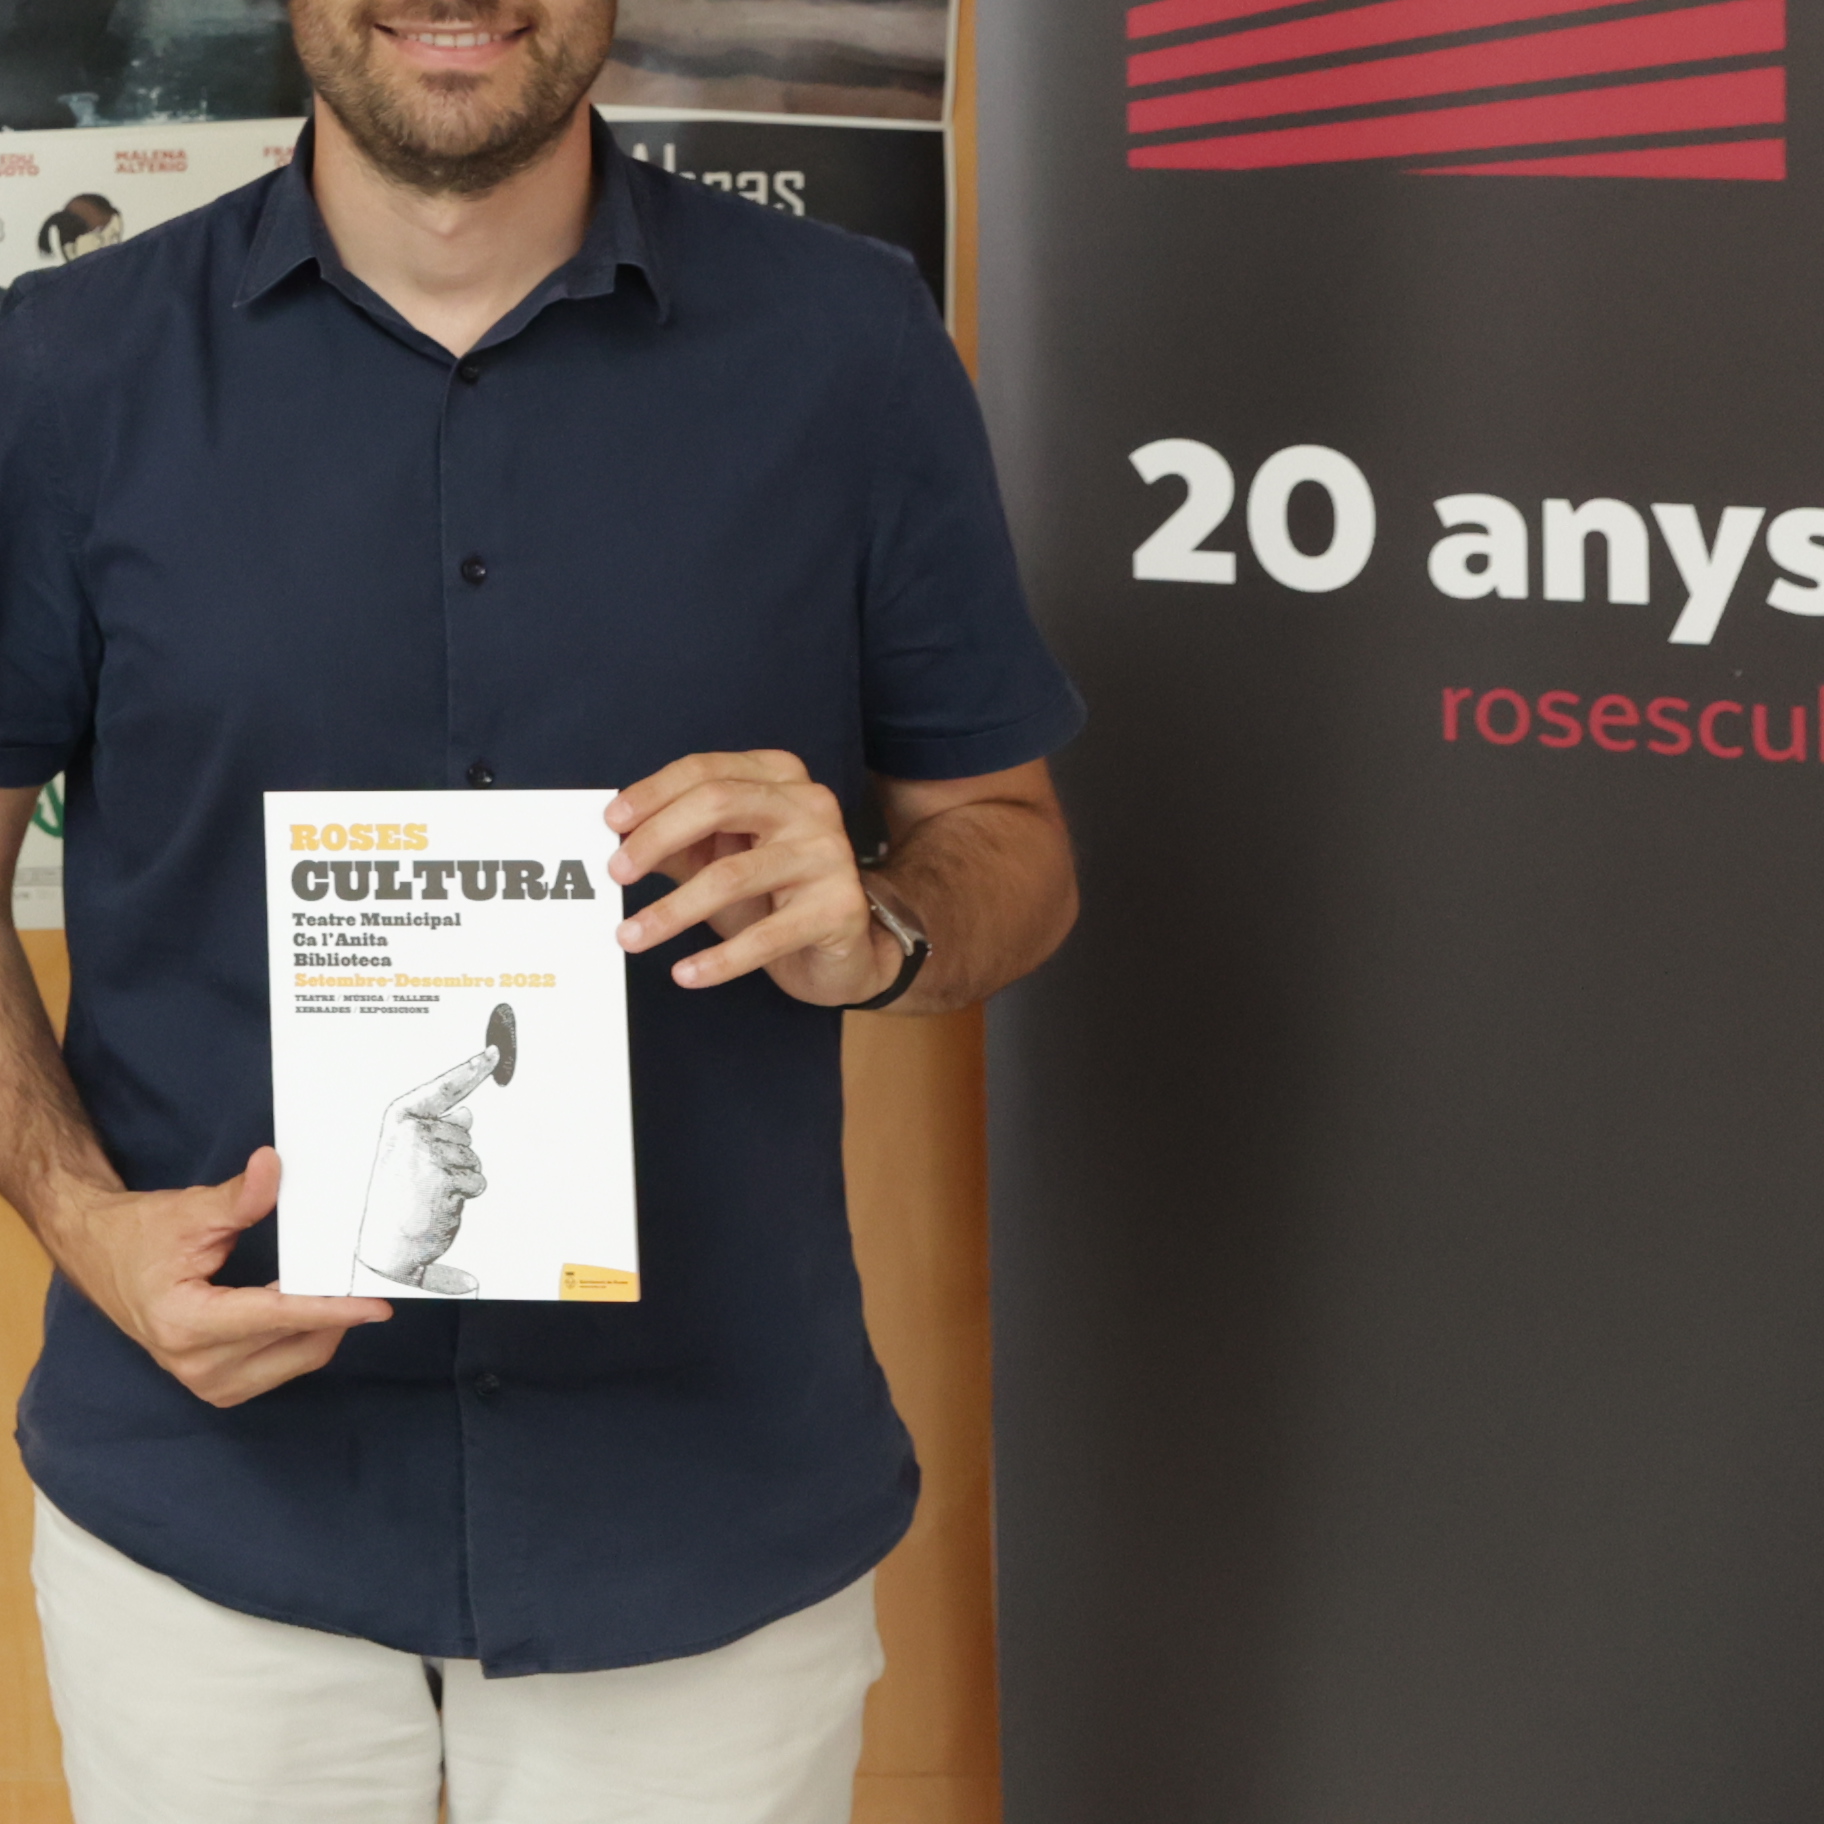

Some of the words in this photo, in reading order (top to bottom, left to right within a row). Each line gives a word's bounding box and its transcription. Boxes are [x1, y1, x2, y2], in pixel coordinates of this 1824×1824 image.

[1128, 437, 1377, 593] 20
[1427, 493, 1824, 645] anys
[290, 823, 429, 852] ROSES
[291, 859, 595, 902] CULTURA
[292, 913, 355, 927] Teatre
[360, 913, 461, 930] Municipal
[293, 933, 319, 946] Ca
[322, 933, 388, 947] l'Anita
[293, 953, 393, 967] Biblioteca
[294, 973, 494, 988] Setembre-Desembre
[500, 973, 557, 988] 2022
[295, 994, 336, 1002] TEATRE
[392, 994, 441, 1002] TALLERS
